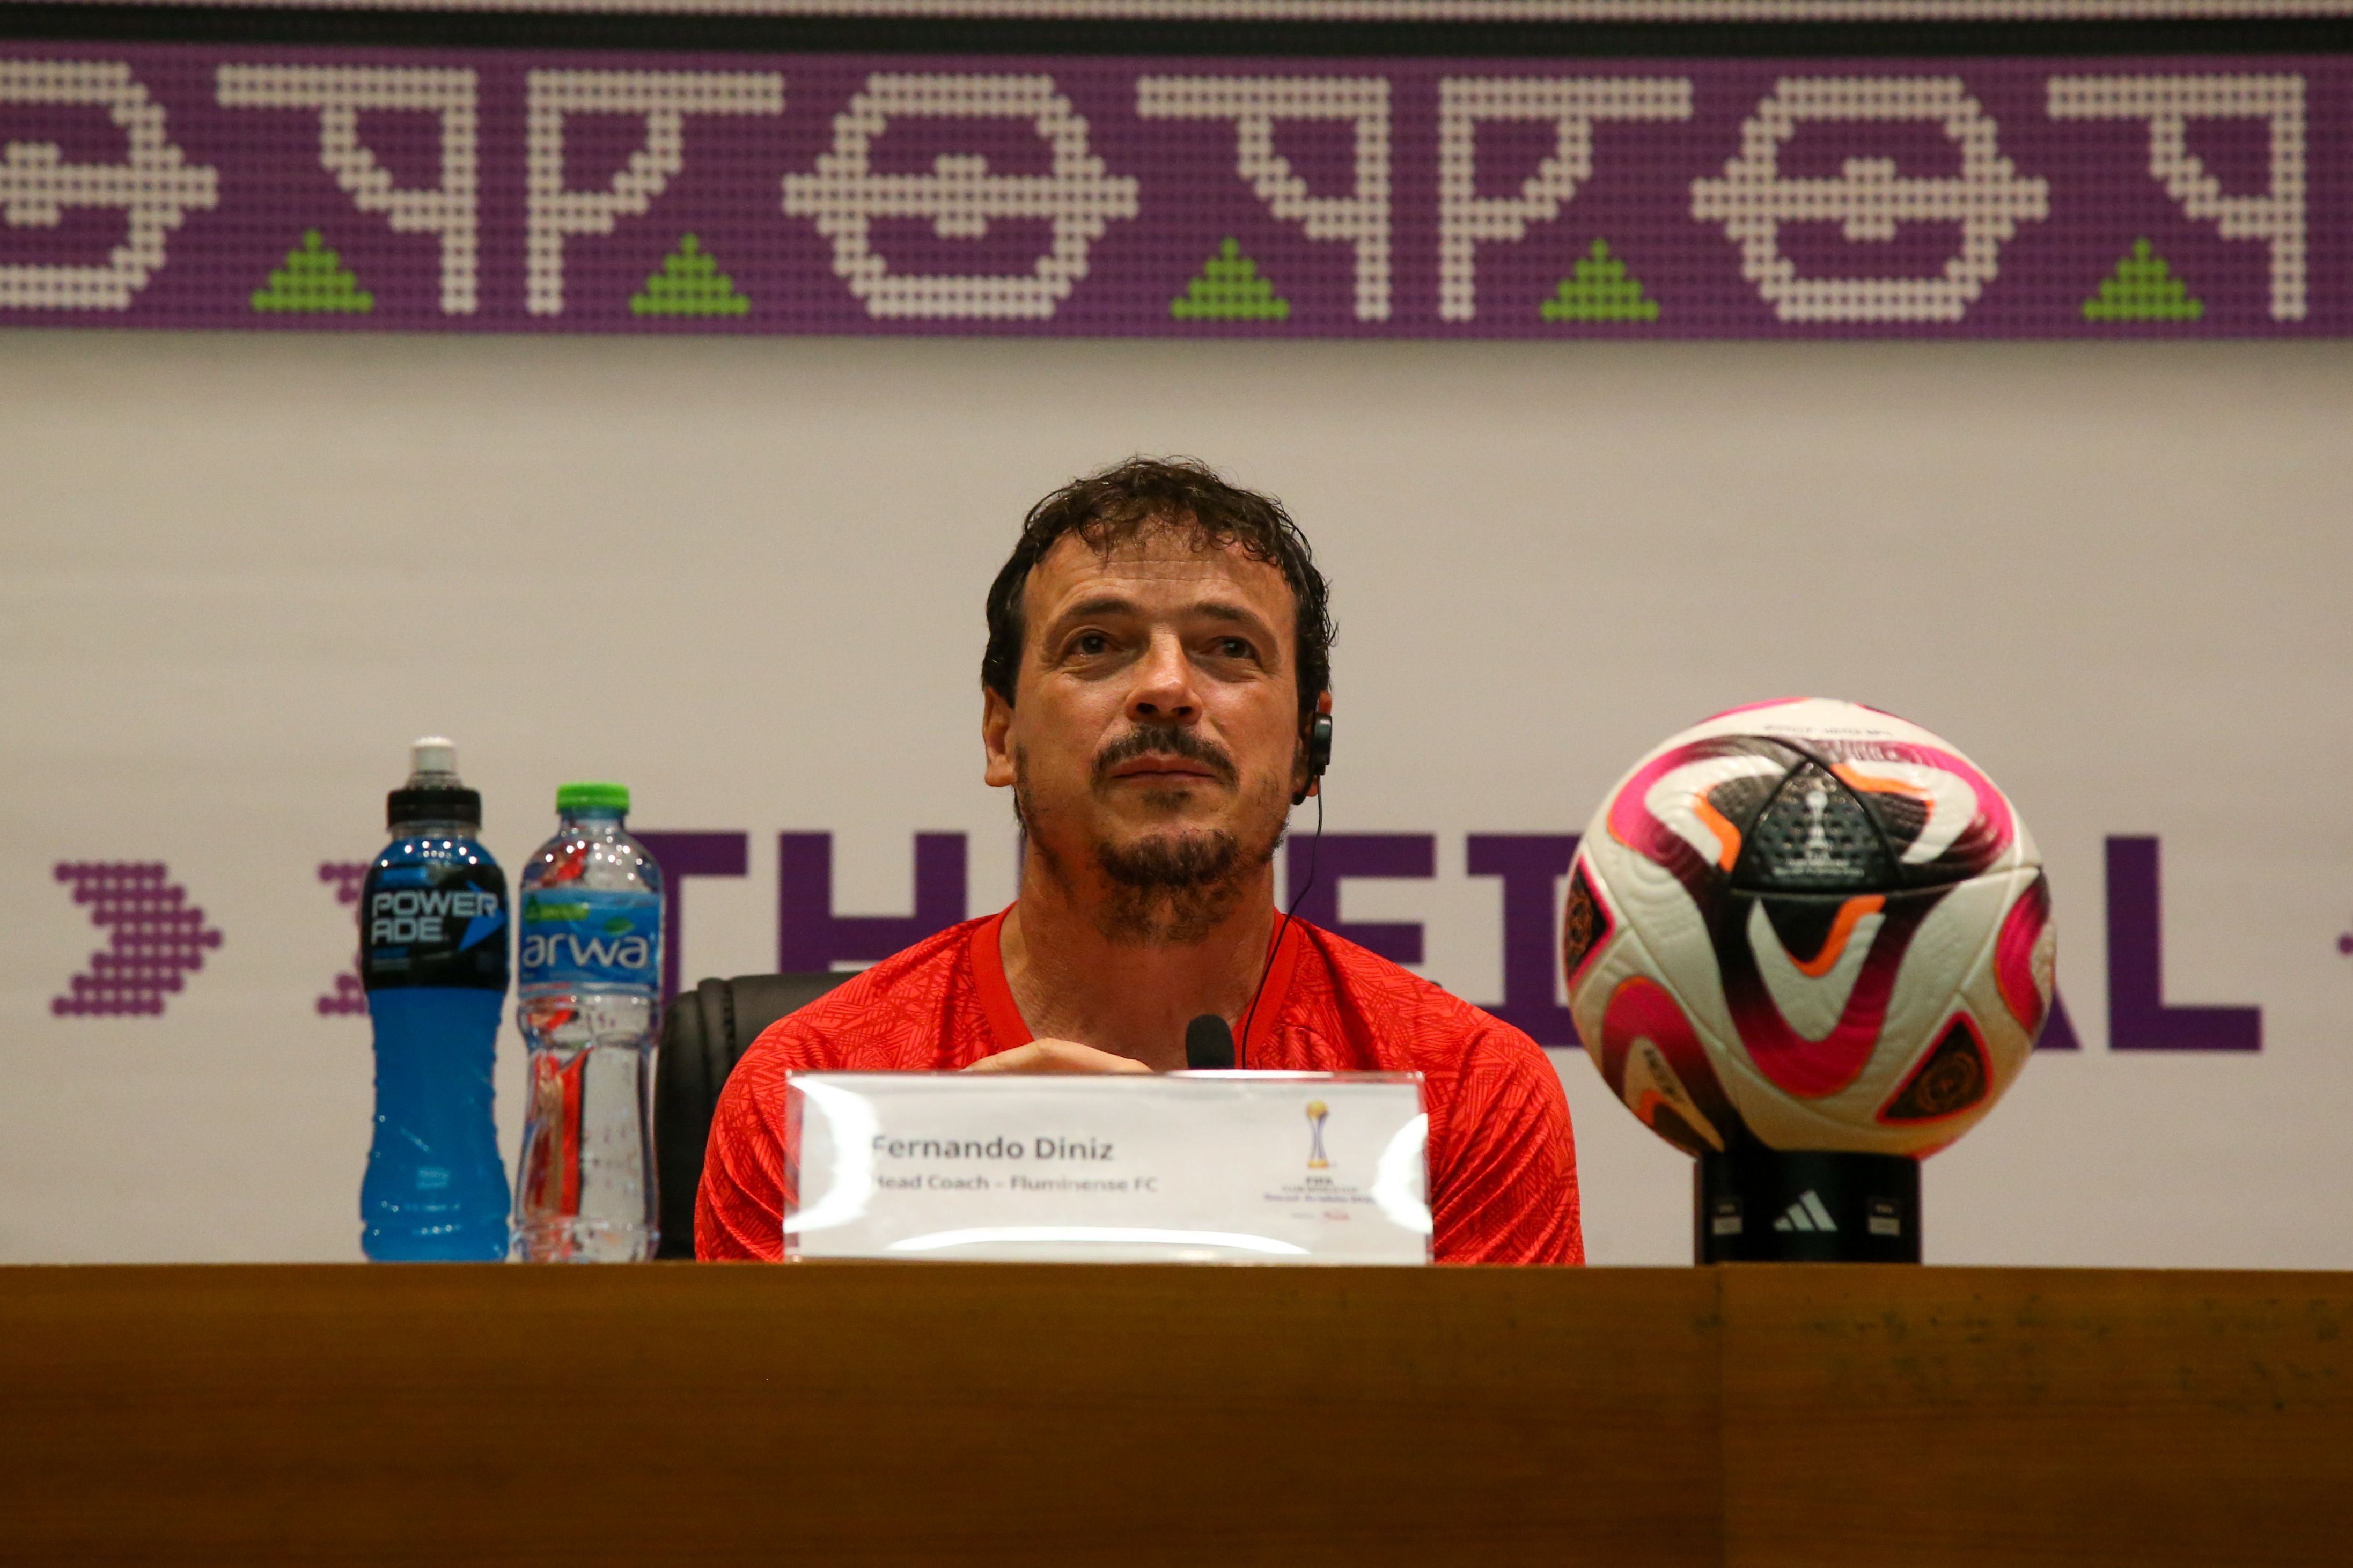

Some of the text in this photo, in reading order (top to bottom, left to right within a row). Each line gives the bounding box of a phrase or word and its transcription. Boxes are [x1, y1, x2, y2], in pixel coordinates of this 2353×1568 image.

[372, 890, 499, 918] POWER
[371, 916, 444, 946] ADE
[628, 831, 1026, 1017] TH
[523, 933, 649, 968] arwa
[872, 1135, 1115, 1160] Fernando Diniz
[928, 1175, 989, 1190] Coach
[1011, 1175, 1128, 1191] Fluminense
[1133, 1177, 1159, 1192] FC
